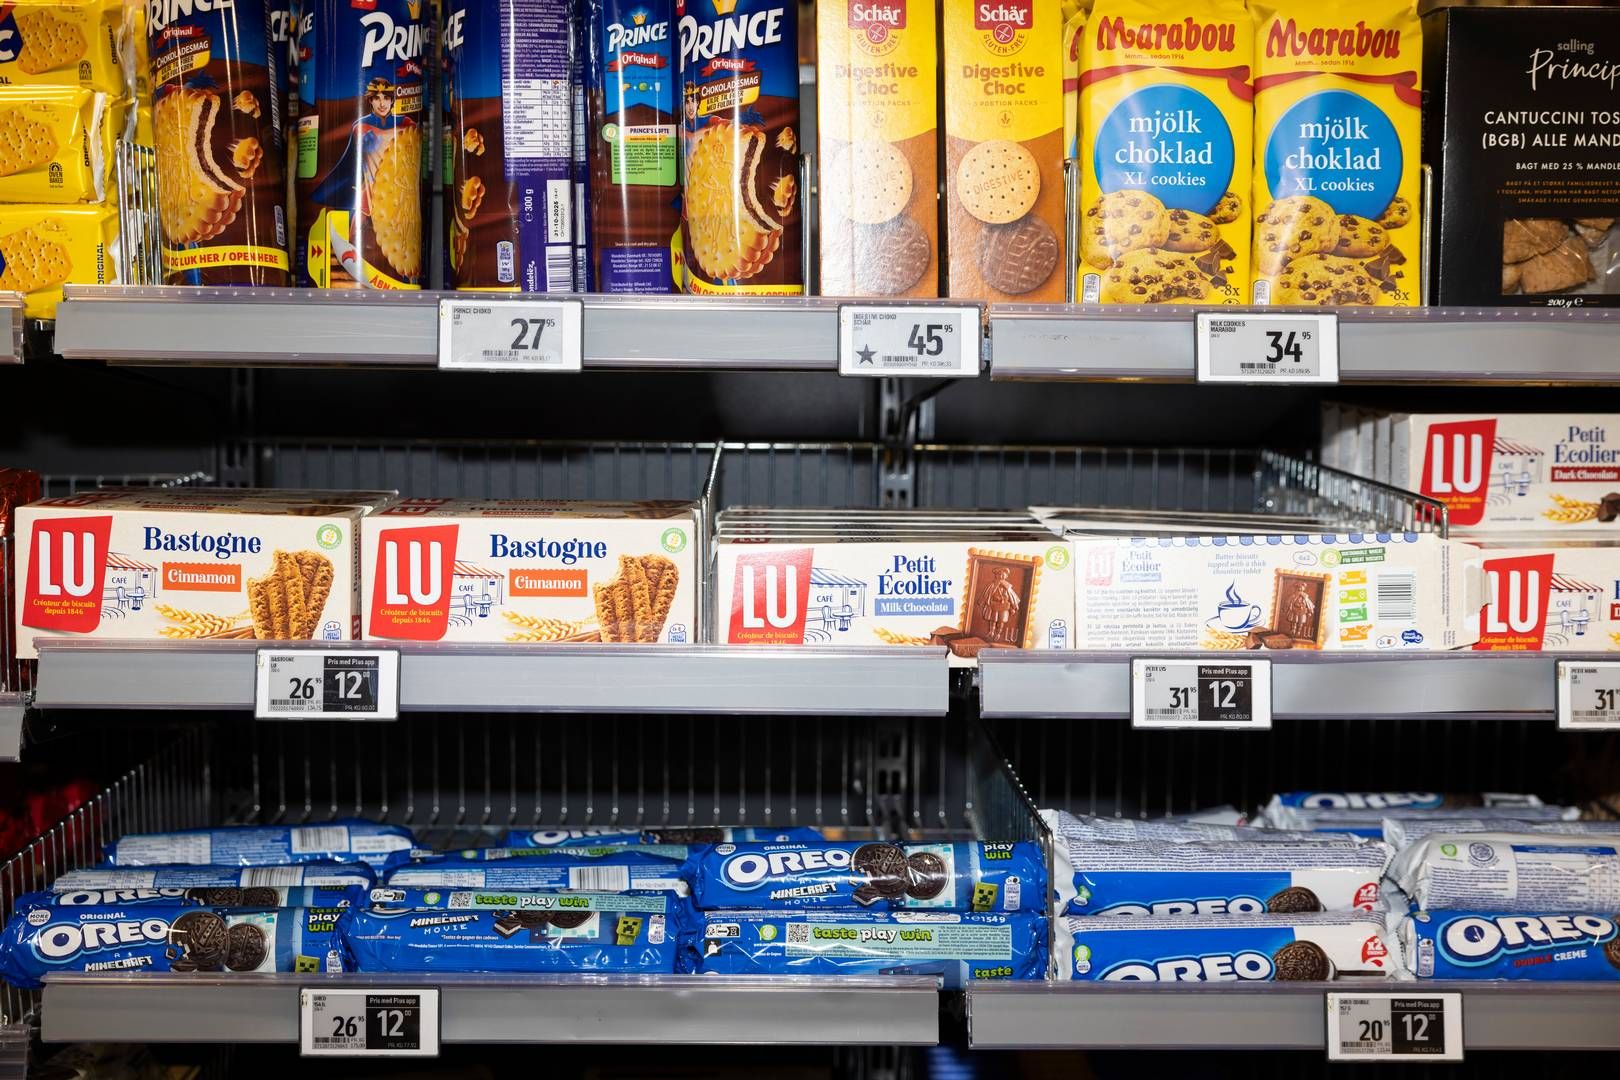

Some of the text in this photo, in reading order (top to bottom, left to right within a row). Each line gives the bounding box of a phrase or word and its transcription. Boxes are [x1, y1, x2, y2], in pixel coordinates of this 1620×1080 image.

[853, 4, 899, 25] Schär
[980, 4, 1027, 25] Schär
[607, 21, 668, 52] PRINCE
[677, 8, 784, 73] PRINCE
[1097, 16, 1236, 52] Marabou
[1266, 19, 1400, 59] Marabou
[983, 33, 1025, 55] GLUTEN-FREE
[1557, 39, 1594, 54] salling
[622, 53, 657, 65] Original
[711, 60, 745, 70] Original
[963, 64, 1045, 81] Digestive
[701, 76, 759, 97] CHOKOLADESMAG
[984, 80, 1026, 95] Choc
[1129, 111, 1202, 142] mjölk
[1484, 111, 1584, 125] CANTUCCINI
[1299, 117, 1370, 148] mjölk
[1482, 133, 1525, 149] (BGB)
[1532, 133, 1566, 147] ALLE
[1115, 141, 1213, 165] choklad
[1285, 147, 1382, 170] choklad
[1516, 162, 1584, 170] BAGT MED 25 %
[1124, 171, 1206, 186] XL cookies
[1295, 178, 1375, 192] XL cookies
[180, 252, 279, 265] LUK HER OPEN HERE
[511, 318, 555, 350] 27 95
[908, 325, 953, 355] 45 95
[1266, 331, 1311, 362] 34 95
[1568, 426, 1605, 443] Petit
[1554, 439, 1620, 464] Écolier
[1431, 434, 1483, 494] LU
[143, 526, 261, 559] Bastogne
[490, 534, 607, 565] Bastogne
[38, 530, 95, 596] LU
[893, 554, 936, 574] Petit
[111, 576, 127, 584] CAFÉ
[168, 568, 236, 585] Cinnamon
[386, 540, 442, 605] LU
[459, 583, 474, 592] CAFÉ
[514, 575, 582, 591] Cinnamon
[878, 569, 952, 596] Écolier
[33, 600, 96, 608] Créateur de biscuits
[742, 565, 797, 629] LU
[816, 594, 833, 603] CAFÉ
[1487, 570, 1540, 633] LU
[44, 607, 65, 616] depuis
[380, 608, 443, 617] Créateur de biscuits
[880, 603, 948, 613] Milk Chocolate
[391, 616, 431, 625] depuis 1846
[765, 631, 773, 639] de
[774, 631, 799, 639] biscuits
[289, 677, 315, 699] 26
[334, 671, 362, 699] 12
[1208, 680, 1236, 708] 12
[1169, 687, 1189, 708] 31
[1595, 689, 1615, 710] 31
[984, 842, 1014, 853] play
[985, 850, 1012, 860] win
[727, 850, 851, 883] OREO
[770, 882, 837, 900] MINECRAFT
[1360, 885, 1376, 896] x2
[475, 894, 517, 906] taste
[521, 895, 556, 908] play
[80, 912, 126, 920] ORIGINAL
[309, 912, 340, 923] play
[410, 914, 480, 927] MINECRAFT
[308, 922, 335, 932] win
[424, 924, 467, 935] MOVIE
[812, 927, 858, 940] taste
[860, 927, 897, 943] play
[1446, 915, 1614, 957] OREO
[38, 919, 169, 957] OREO
[1367, 938, 1384, 950] x2
[85, 956, 153, 972] MINECRAFT
[1554, 950, 1587, 961] CREME
[974, 967, 1012, 977] taste
[333, 1016, 358, 1037] 26
[376, 1010, 404, 1037] 12
[1359, 1020, 1383, 1041] 20
[1402, 1014, 1429, 1041] 12
